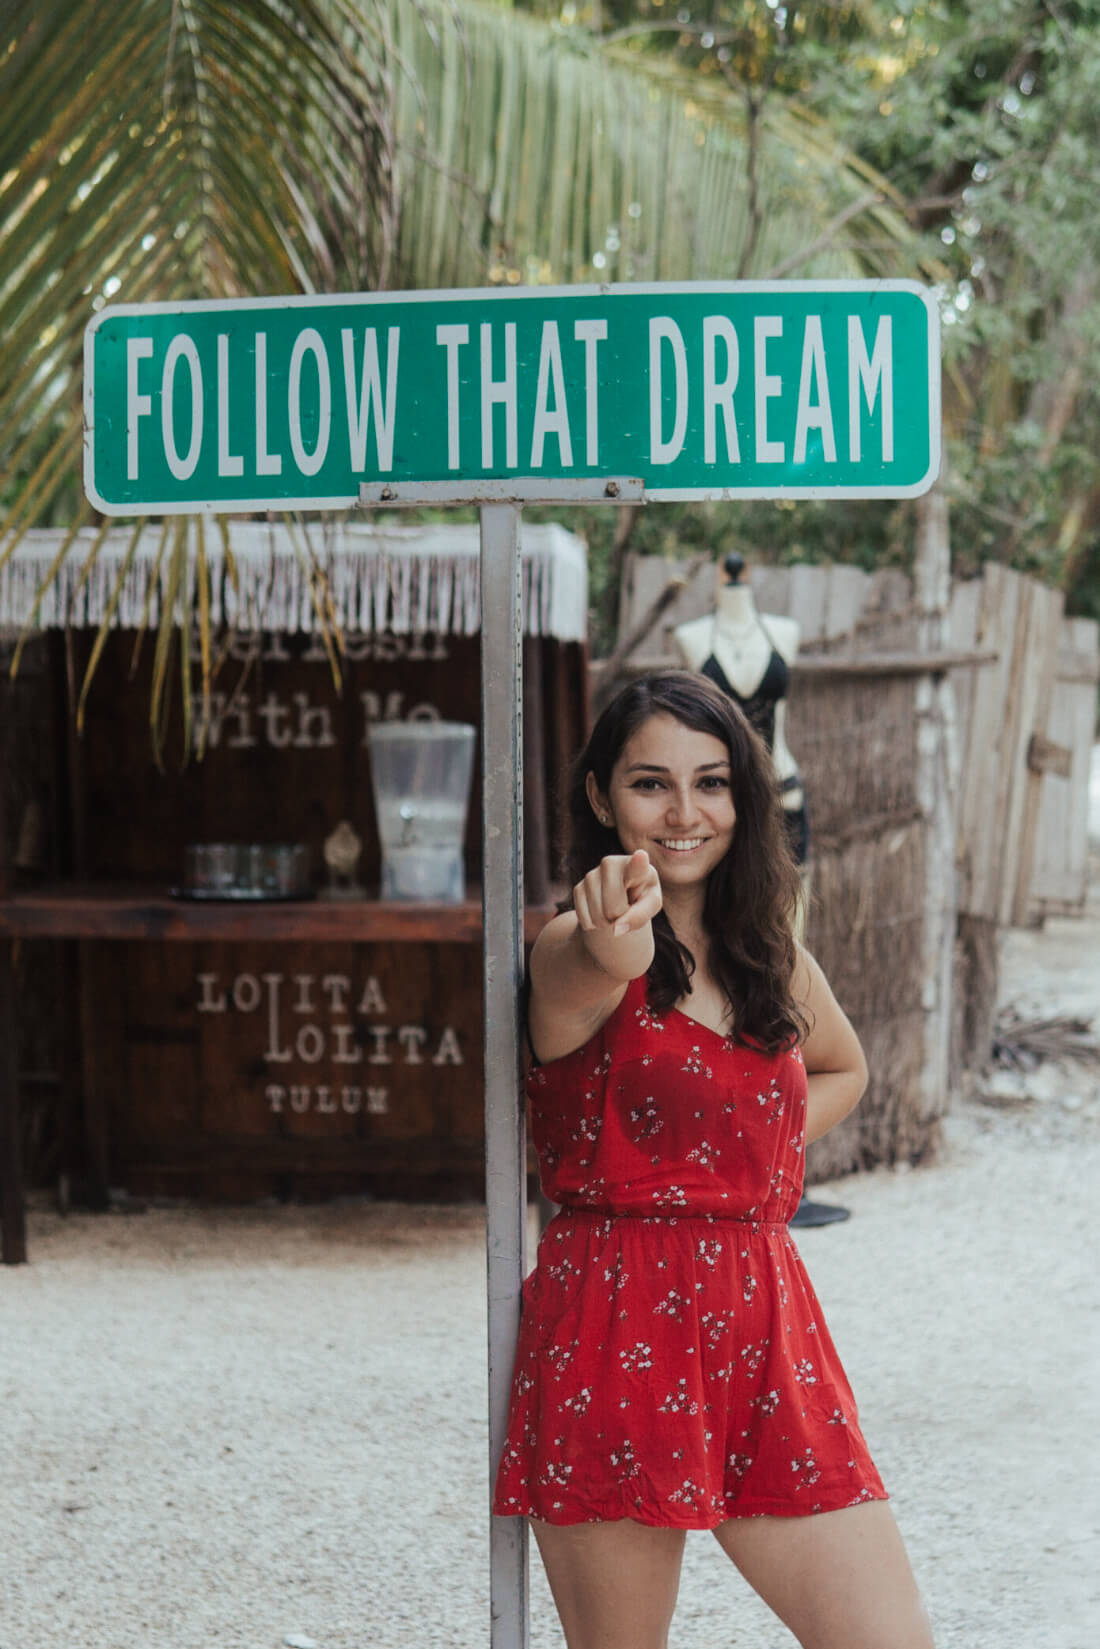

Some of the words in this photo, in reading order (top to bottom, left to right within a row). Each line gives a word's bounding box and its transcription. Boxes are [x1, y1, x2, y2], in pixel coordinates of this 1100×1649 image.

[126, 327, 401, 482] FOLLOW
[435, 318, 608, 470] THAT
[647, 314, 894, 465] DREAM
[265, 1085, 389, 1114] TULUM
